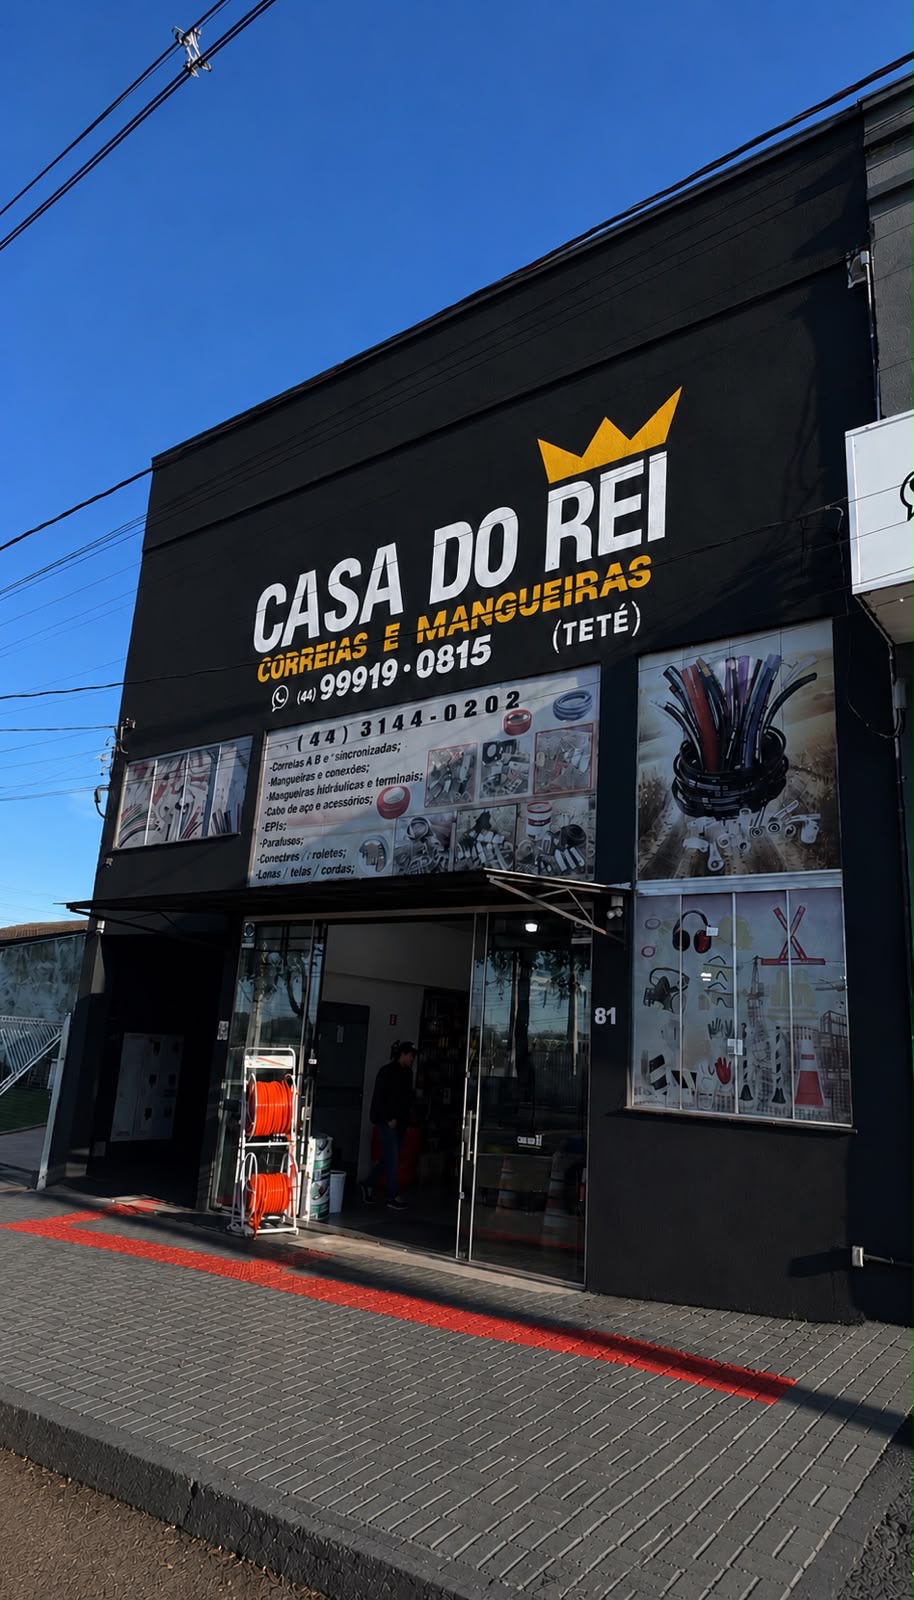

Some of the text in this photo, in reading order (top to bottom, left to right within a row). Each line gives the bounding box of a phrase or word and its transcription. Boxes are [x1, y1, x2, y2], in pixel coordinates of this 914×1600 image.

[254, 451, 668, 653] CASA DO REI
[257, 555, 652, 683] CORREIAS E MANGUEIRAS
[552, 601, 641, 653] (TETÉ)
[297, 687, 317, 705] (44)
[306, 756, 312, 767] A
[314, 754, 321, 765] B
[316, 780, 364, 795] hidráulicas
[367, 780, 373, 788] e
[375, 772, 423, 787] terminais;
[318, 770, 323, 780] e
[287, 804, 297, 814] de
[299, 804, 313, 816] aço
[315, 802, 321, 810] e
[323, 796, 373, 809] acessórios;
[290, 866, 312, 877] telas
[321, 864, 355, 875] cordas;
[595, 1007, 616, 1025] 81
